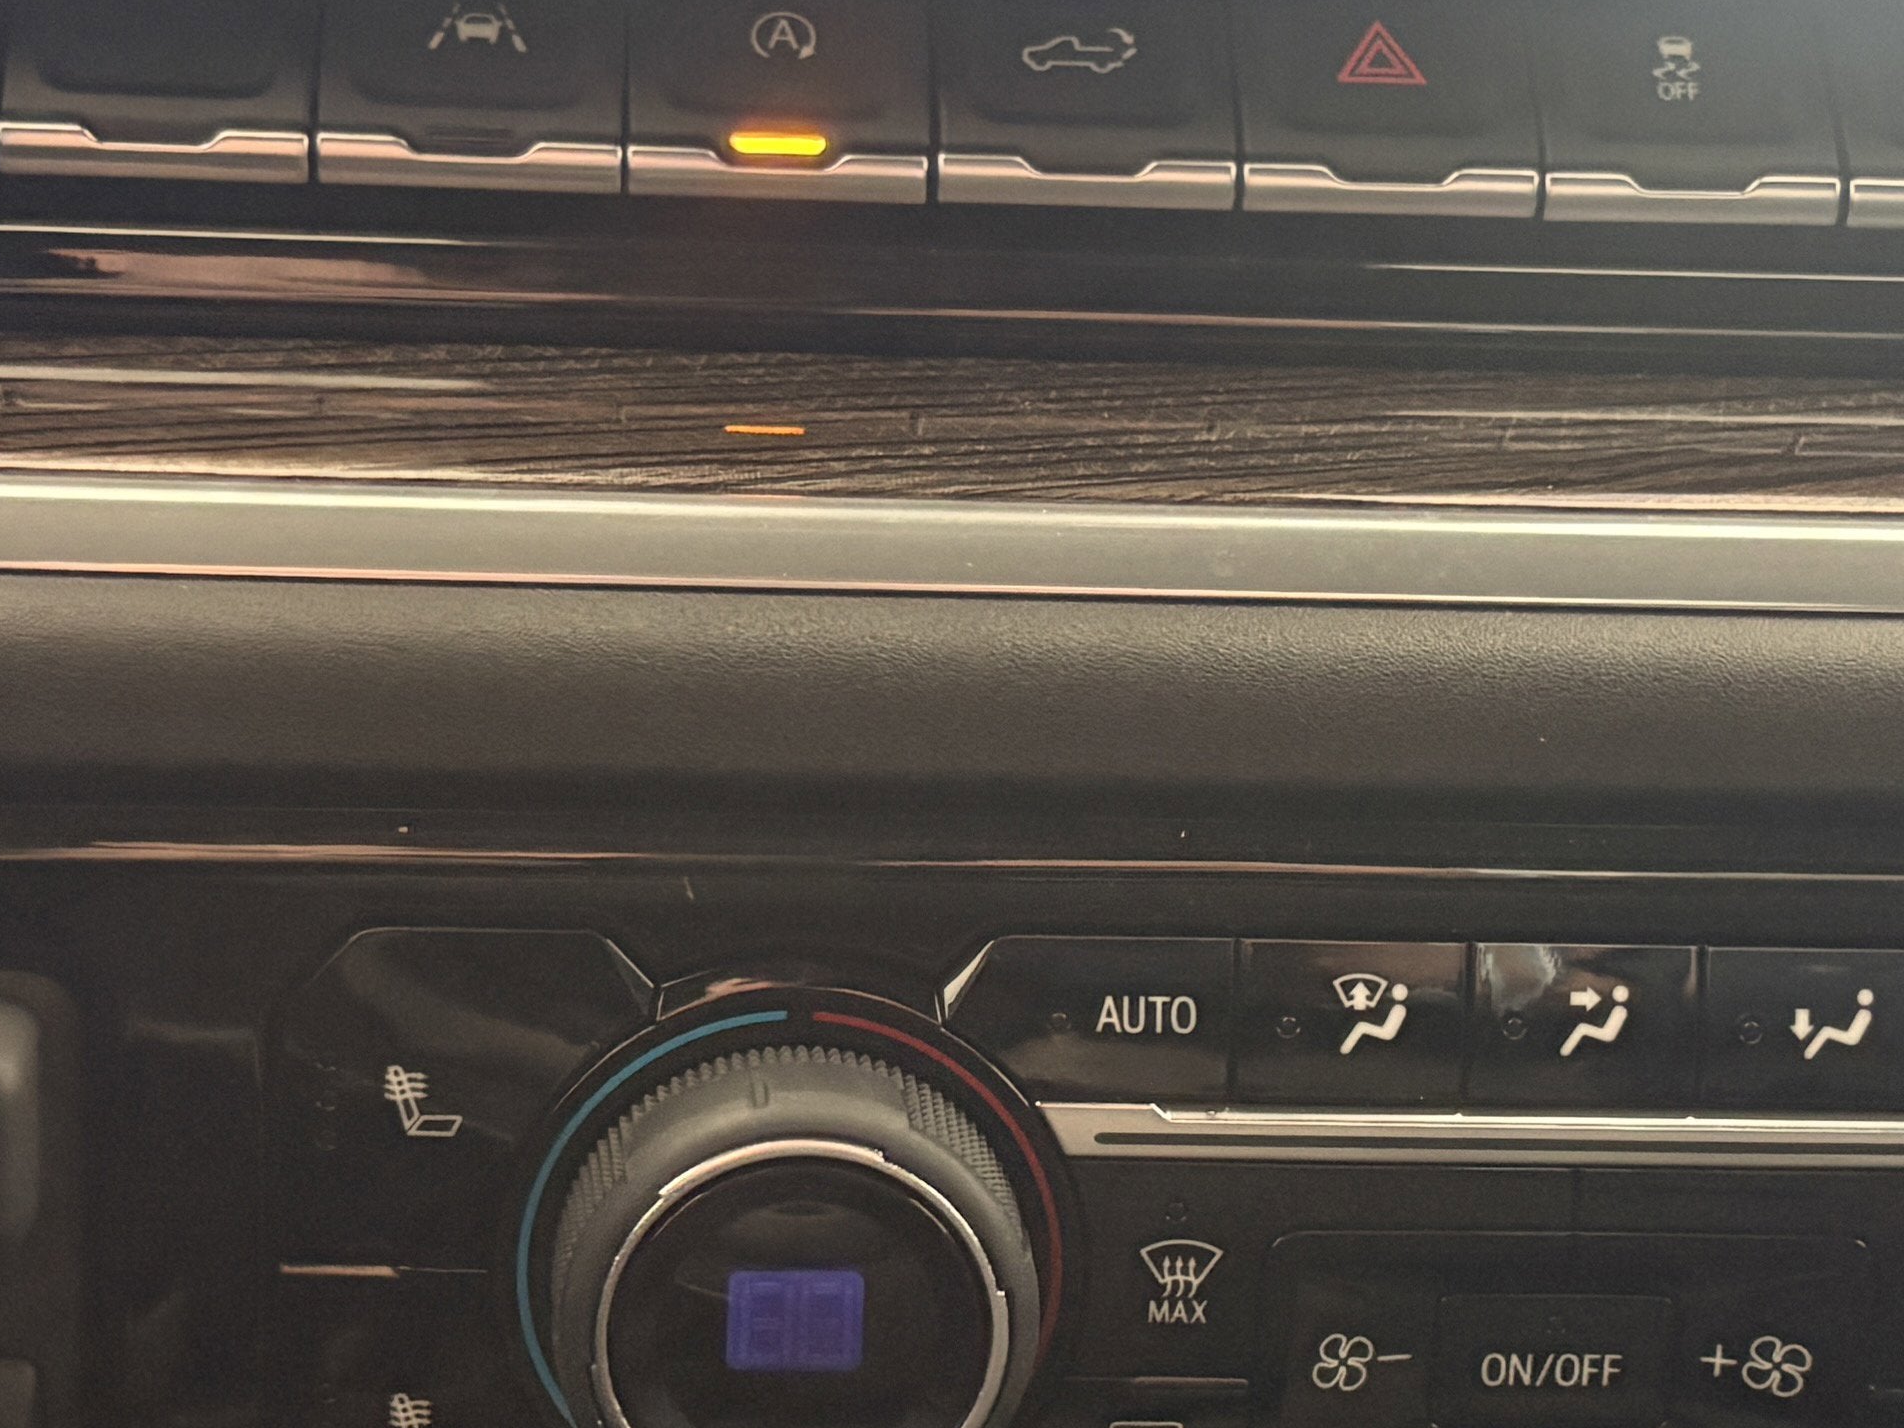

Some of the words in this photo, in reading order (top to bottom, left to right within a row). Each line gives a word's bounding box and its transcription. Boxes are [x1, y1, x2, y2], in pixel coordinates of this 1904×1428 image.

[1656, 80, 1701, 102] OFF
[1095, 995, 1198, 1036] AUTO
[1147, 1299, 1208, 1326] MAX
[1481, 1352, 1623, 1389] ON/OFF
